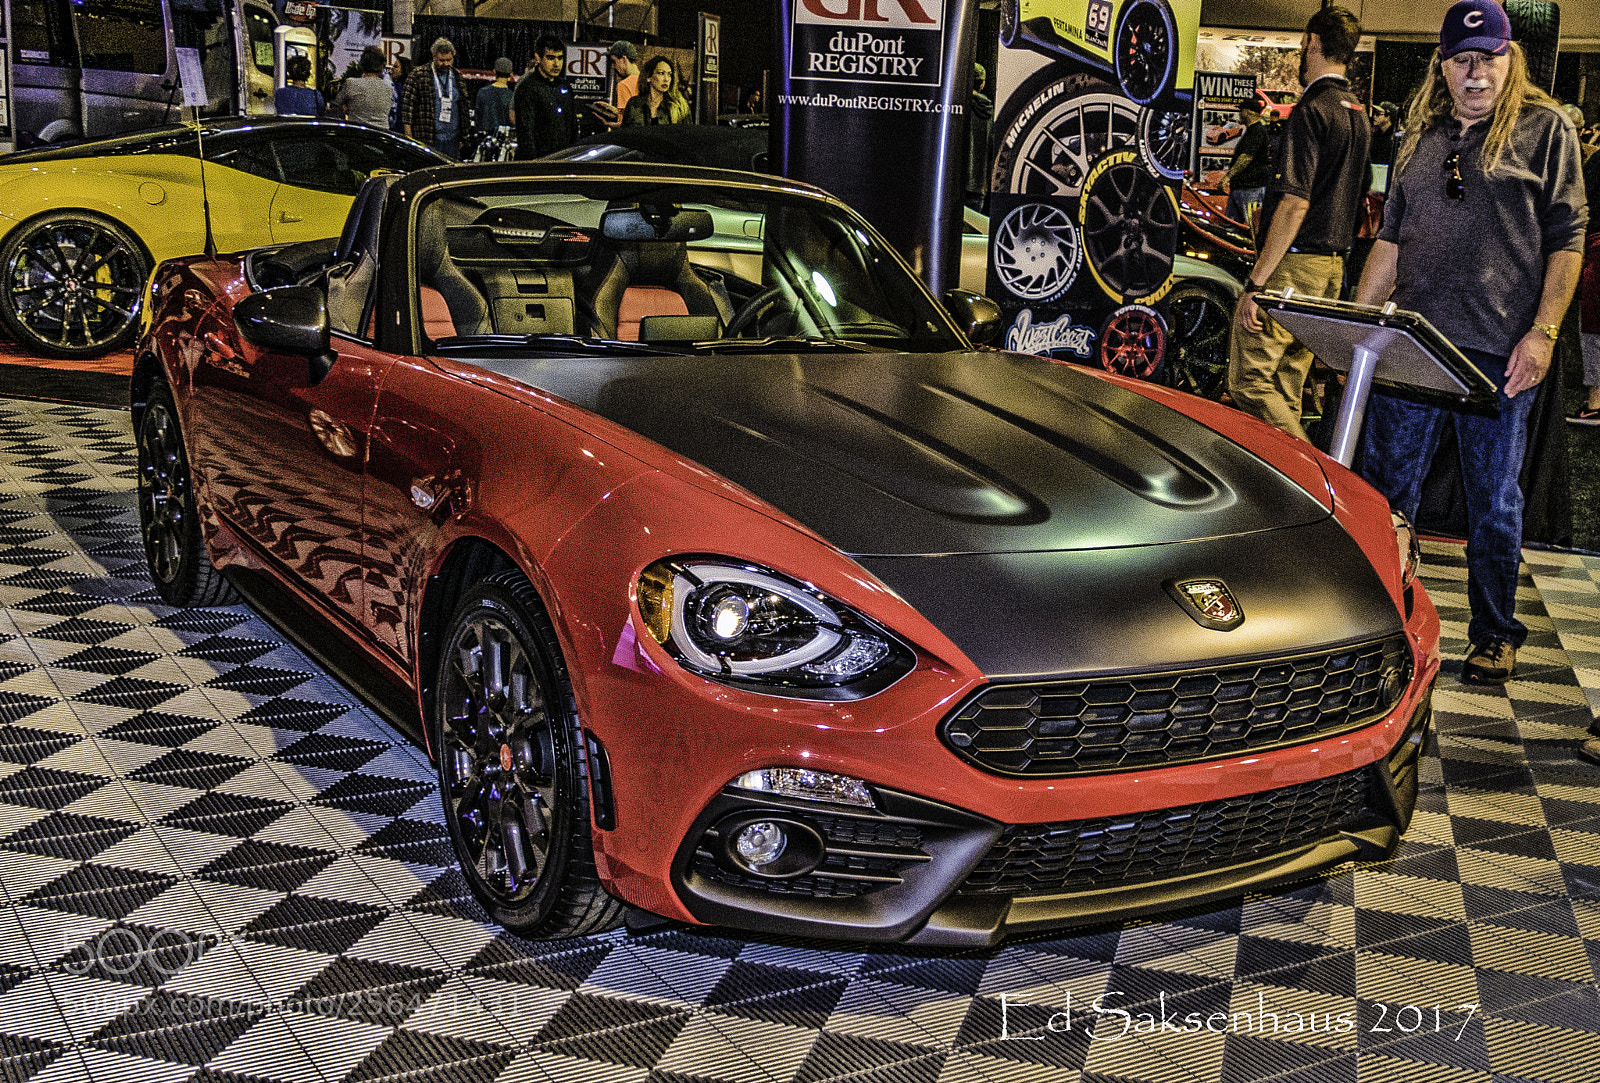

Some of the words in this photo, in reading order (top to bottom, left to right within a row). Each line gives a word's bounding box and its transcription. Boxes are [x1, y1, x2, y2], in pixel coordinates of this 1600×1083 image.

[1053, 17, 1083, 39] PERTAMINA
[1089, 2, 1110, 32] 69
[1463, 10, 1484, 28] C
[829, 31, 906, 55] duPont
[807, 52, 924, 77] REGISTRY
[1200, 76, 1233, 97] WIN
[1234, 78, 1255, 87] THESE
[1233, 87, 1254, 99] CARS
[778, 93, 964, 115] www.duPontREGISTRY.com
[1005, 81, 1066, 149] MICHELIN
[1078, 151, 1138, 225] SKYACTIV
[1052, 314, 1096, 355] Coast
